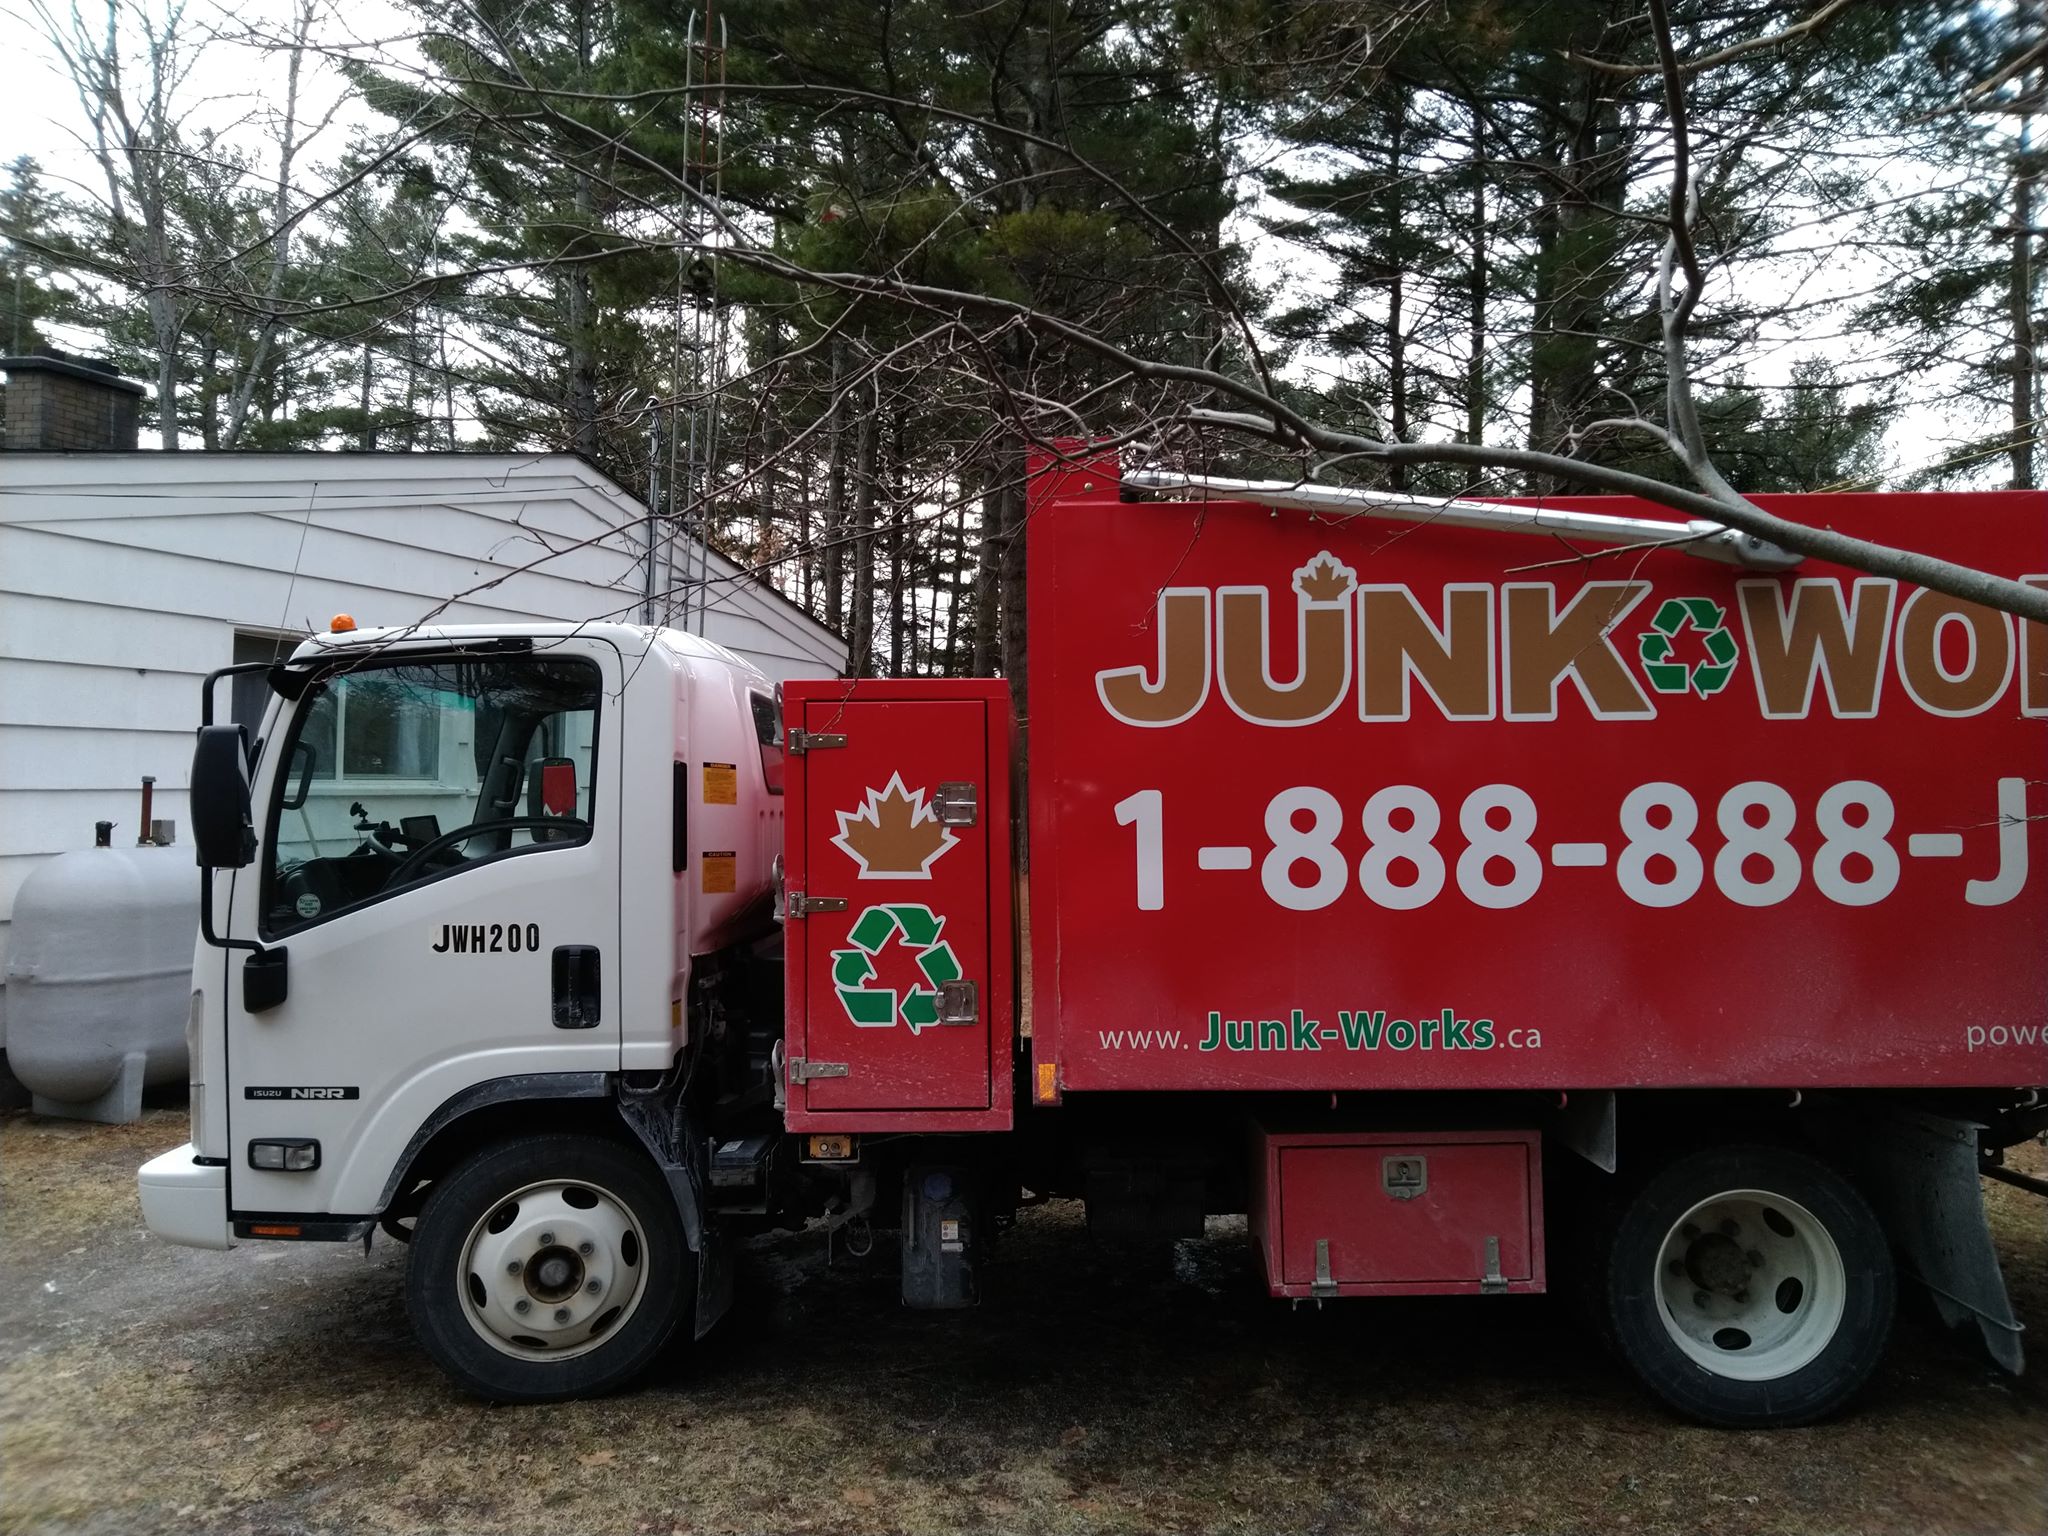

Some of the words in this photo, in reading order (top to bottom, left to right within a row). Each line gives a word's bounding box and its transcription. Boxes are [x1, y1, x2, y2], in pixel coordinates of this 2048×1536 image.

[1095, 581, 1658, 727] JUNK
[1738, 574, 2048, 720] WO
[432, 923, 540, 953] JWH200
[291, 1088, 345, 1099] NRR
